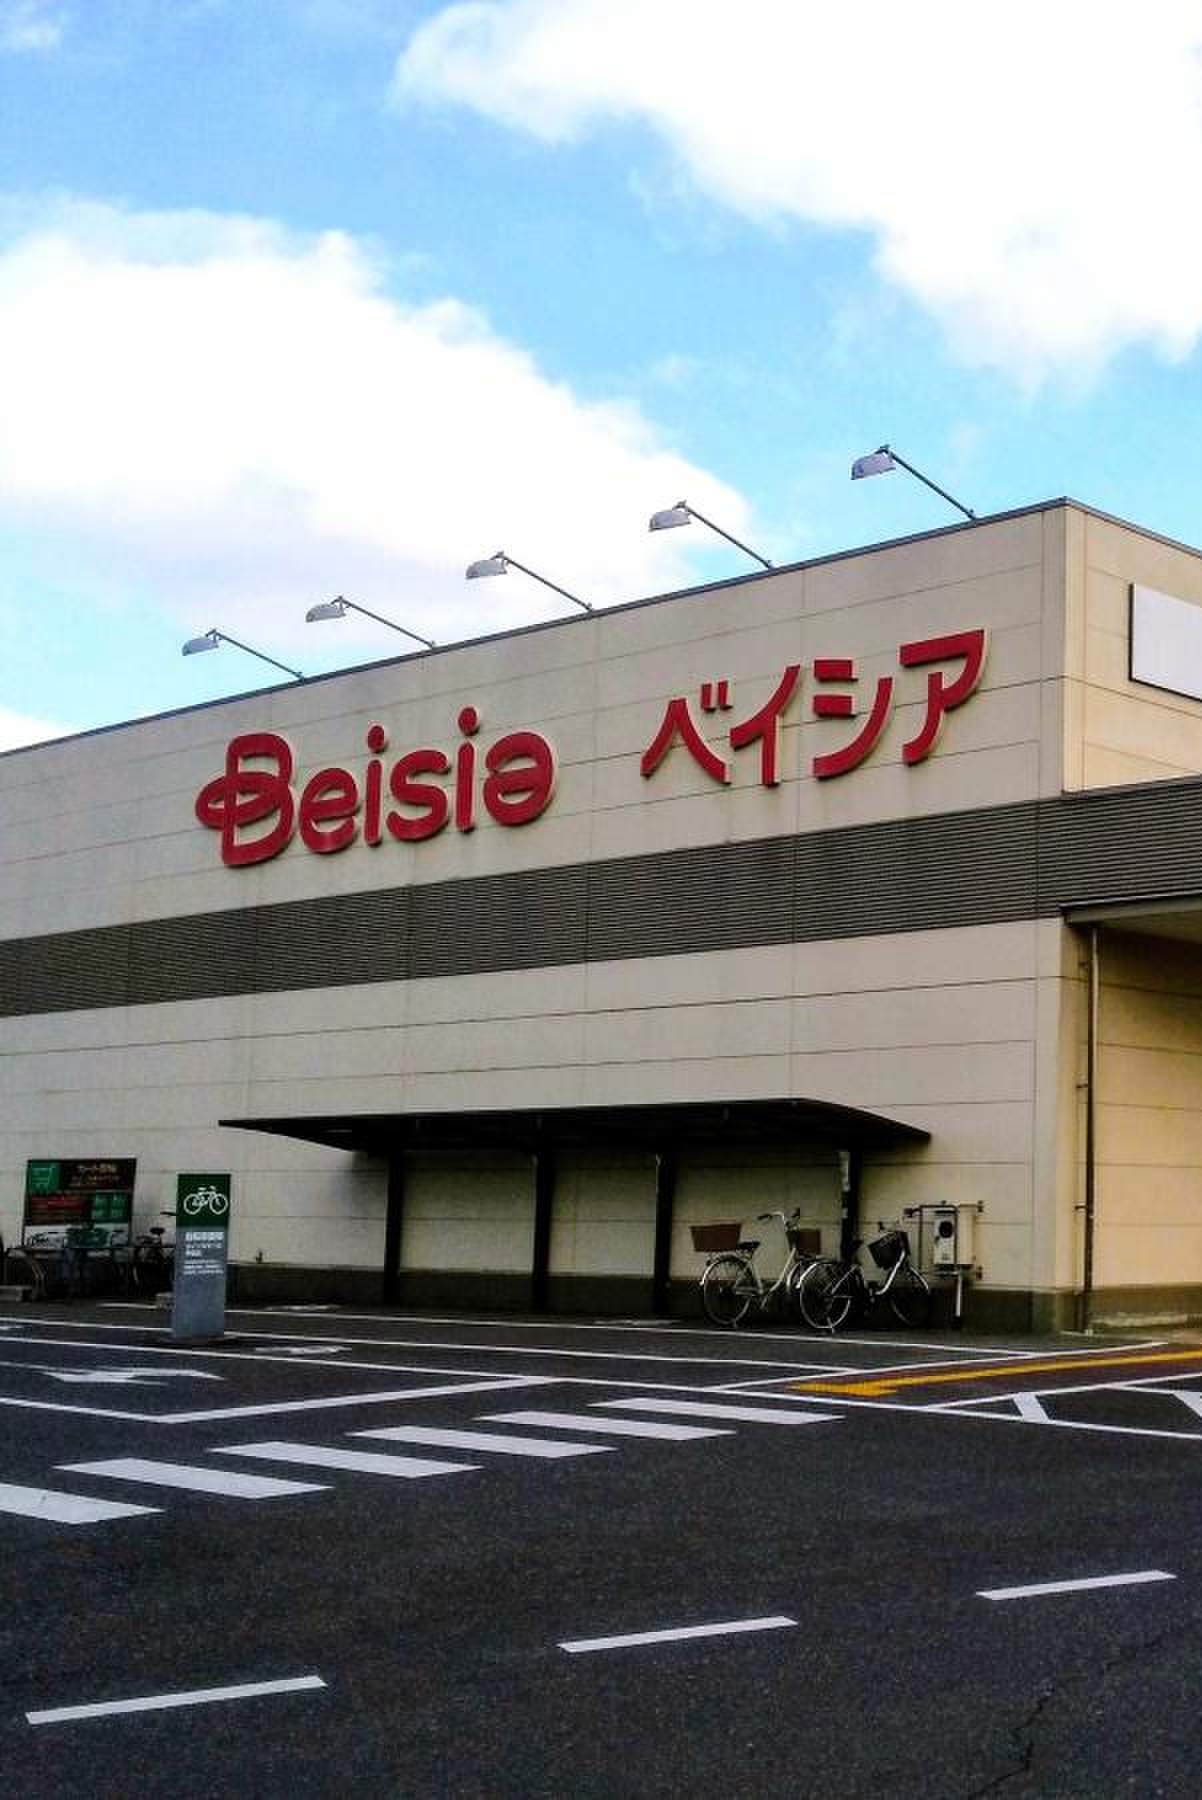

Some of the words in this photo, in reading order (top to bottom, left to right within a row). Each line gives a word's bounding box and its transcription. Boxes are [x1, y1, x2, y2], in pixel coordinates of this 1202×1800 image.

[195, 705, 557, 867] Beisia
[640, 629, 989, 786] ベイシア
